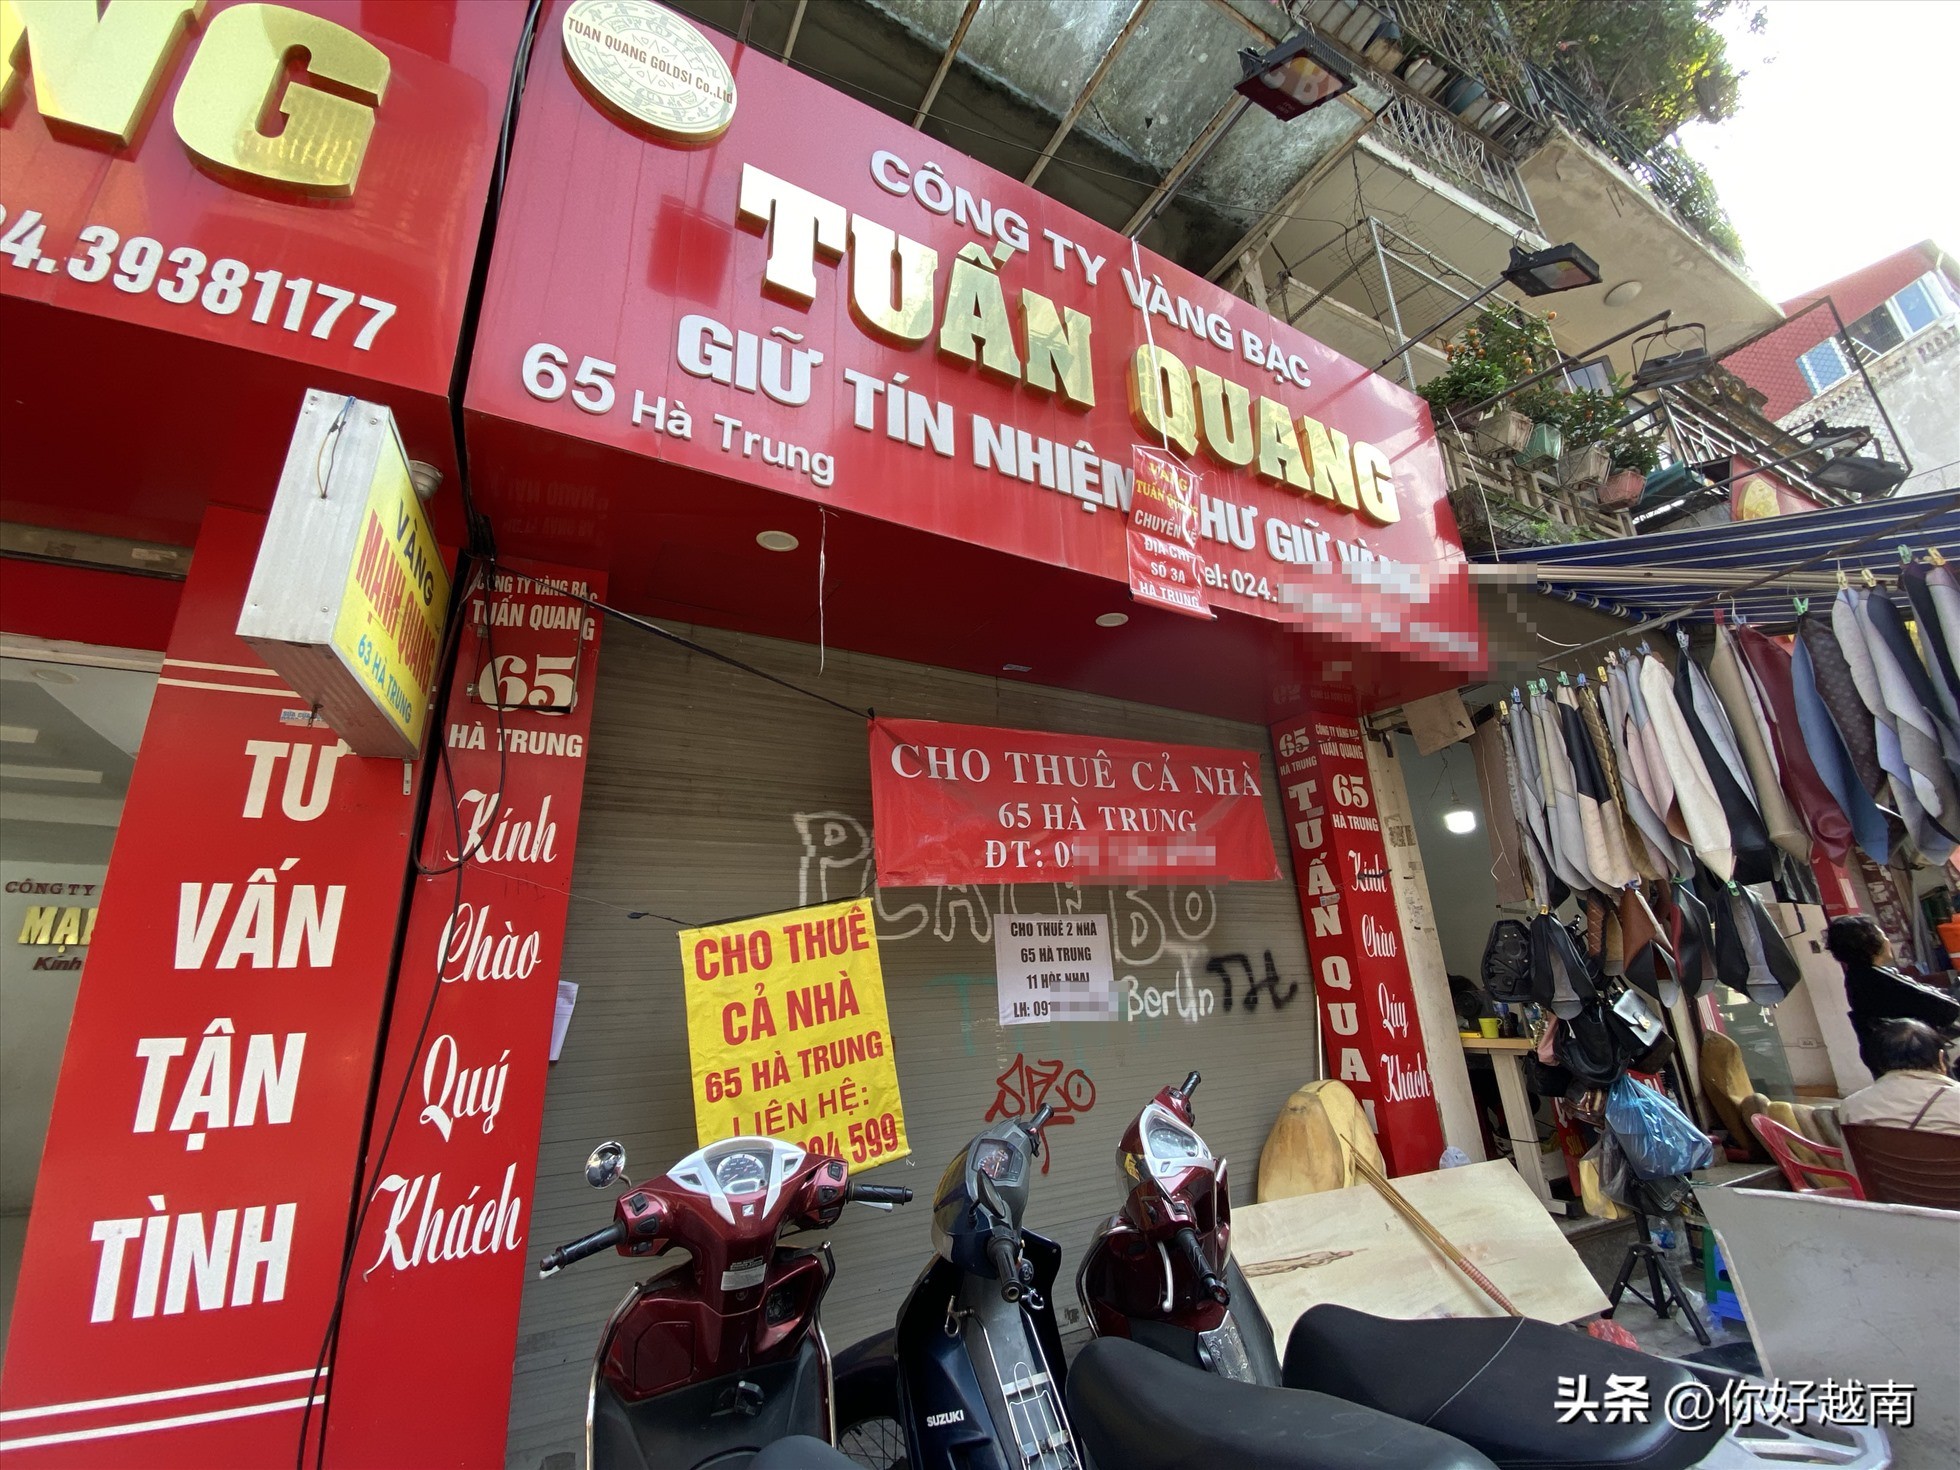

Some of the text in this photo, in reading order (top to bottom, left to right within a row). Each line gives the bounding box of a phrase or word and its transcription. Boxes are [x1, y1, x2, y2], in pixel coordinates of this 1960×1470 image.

[568, 17, 601, 44] TUAN
[605, 34, 647, 64] QUANG
[650, 55, 692, 86] GOLDSI
[0, 203, 397, 351] 4.39381177
[870, 150, 1312, 388] CÔNG TY VÀNG BẠC
[736, 162, 1401, 525] TUẤN QUANG
[522, 343, 835, 487] 65 Hà Trung
[677, 314, 823, 406] GIỮ
[844, 367, 955, 458] TÍN
[1200, 493, 1258, 551] HƯ
[396, 499, 434, 607] VÀNG
[1203, 563, 1229, 590] el:
[473, 595, 595, 641] TUẤN QUANG
[1160, 586, 1200, 608] TRUNG
[398, 590, 436, 698] QUANG
[358, 634, 413, 724] 63 HÀ TRUNG
[479, 653, 578, 717] 65
[448, 721, 583, 758] HÀ TRUNG
[1279, 727, 1310, 758] 65
[1291, 755, 1317, 773] TRUNG
[1340, 743, 1364, 759] QUANG
[242, 737, 354, 822] TƯ
[891, 743, 1263, 797] CHO THUÊ CẢ NHÀ
[1332, 773, 1369, 808] 65
[443, 788, 559, 864] Kính
[998, 796, 1197, 833] 65 HÀ TRUNG
[1332, 811, 1380, 832] HÀ TRUNG
[984, 839, 1045, 869] ĐT:
[5, 878, 96, 896] CÔNG TY
[173, 857, 347, 970] VẤN
[437, 901, 543, 984] Chào
[694, 905, 869, 981] CHO THUÊ
[1010, 919, 1098, 937] CHO THUÊ 2 NHÀ
[1021, 945, 1092, 963] 65 HÀ TRUNG
[1361, 914, 1397, 958] Chào
[33, 955, 82, 971] Kính
[1026, 974, 1038, 990] 11
[722, 982, 777, 1046] CẢ
[786, 970, 860, 1032] NHÀ
[1013, 1001, 1030, 1018] LH:
[1378, 982, 1409, 1040] Quý
[132, 1017, 307, 1152] TẬN
[419, 1034, 511, 1143] Quý
[705, 1030, 883, 1103] 65 HÀ TRUNG
[1380, 1052, 1431, 1103] Khách
[848, 1112, 899, 1164] 599
[362, 1161, 523, 1284] Khách
[90, 1194, 298, 1324] TÌNH
[926, 1409, 965, 1428] SUZUKI
